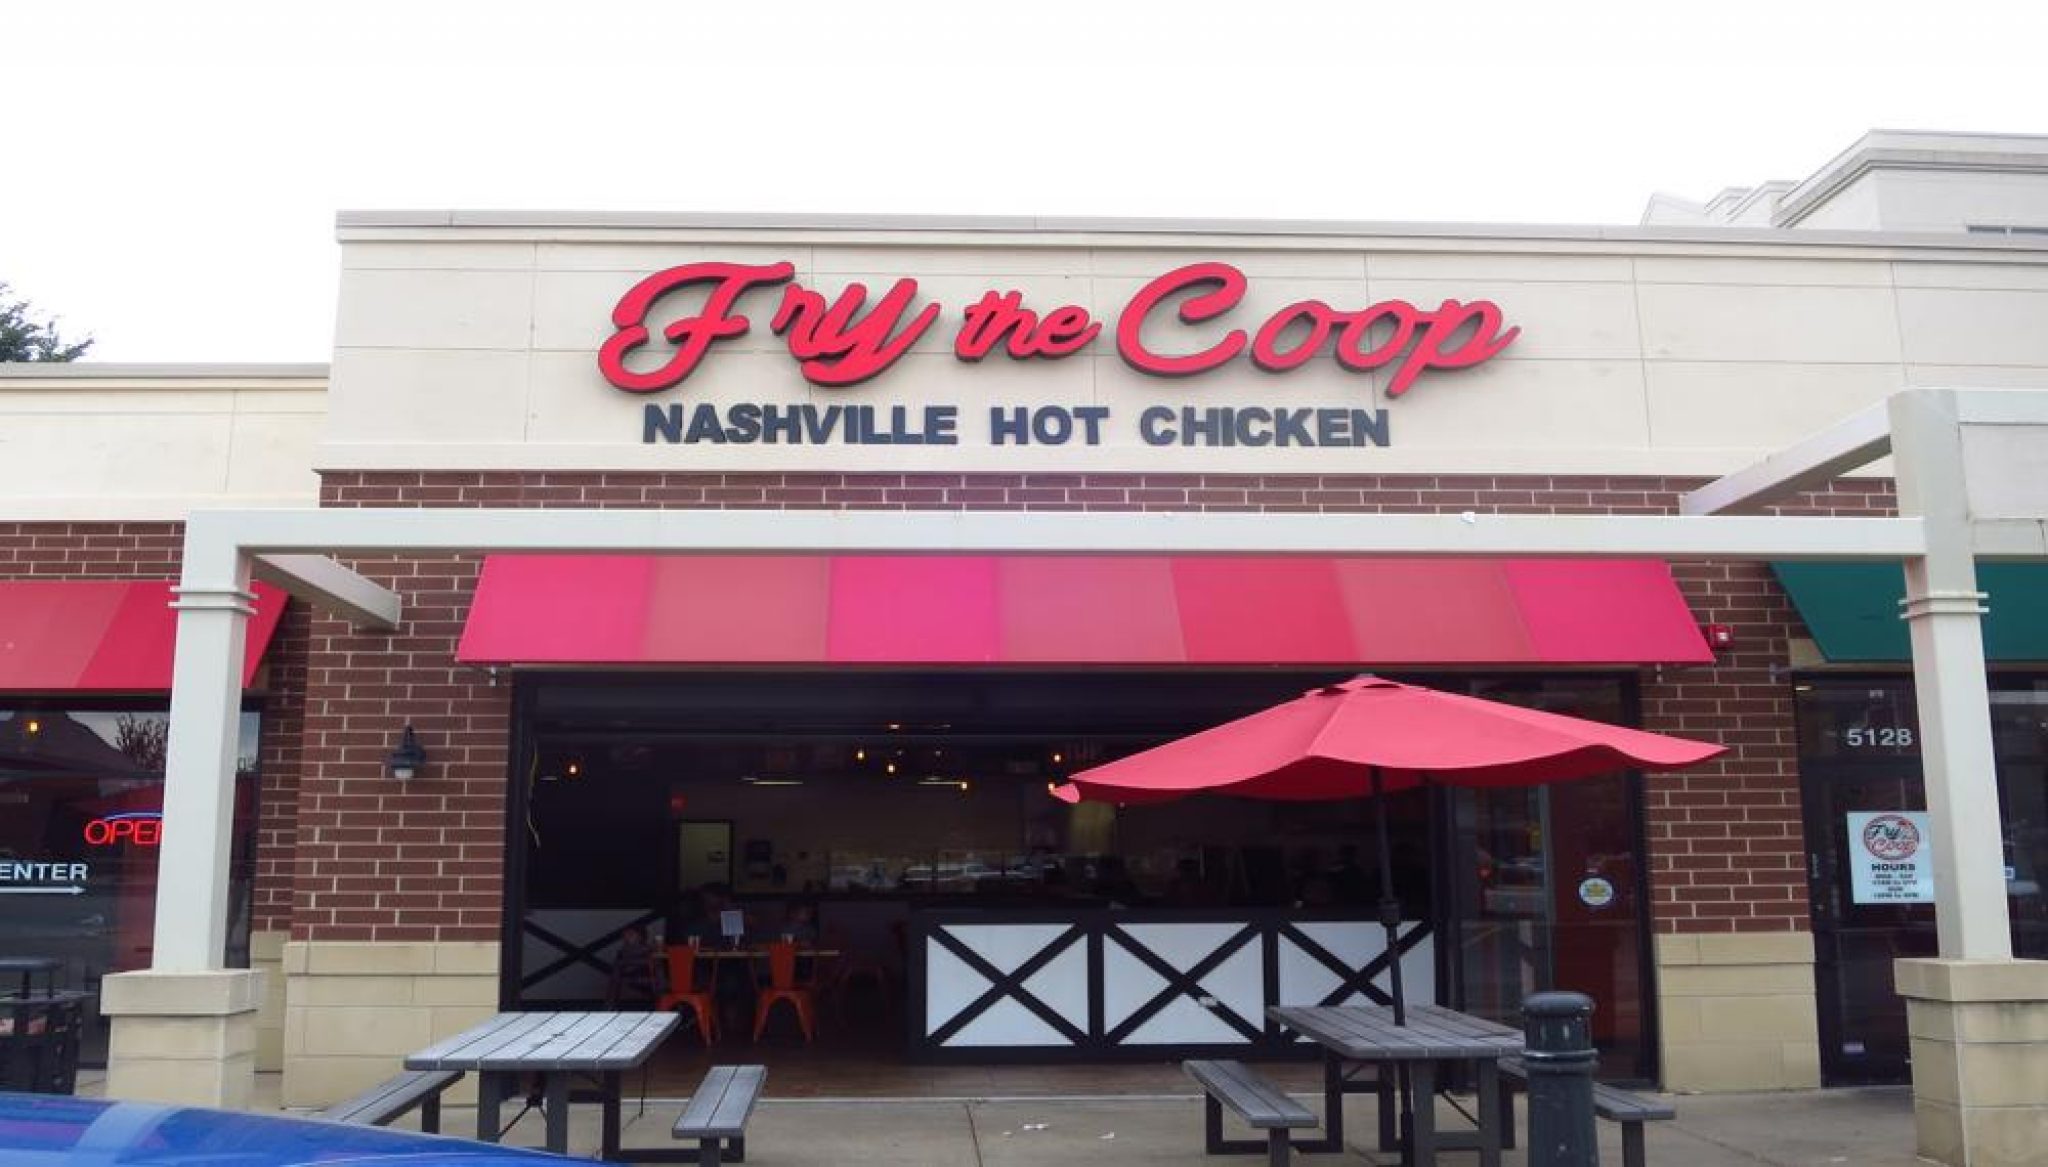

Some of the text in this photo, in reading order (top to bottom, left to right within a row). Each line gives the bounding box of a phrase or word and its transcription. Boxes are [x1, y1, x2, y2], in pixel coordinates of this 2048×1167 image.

[598, 261, 1523, 399] Fry the Coop
[643, 403, 1391, 447] NASHVILLE HOT CHICKEN
[1847, 728, 1912, 746] 5128
[0, 863, 88, 880] ENTER
[1871, 863, 1916, 871] HOURS
